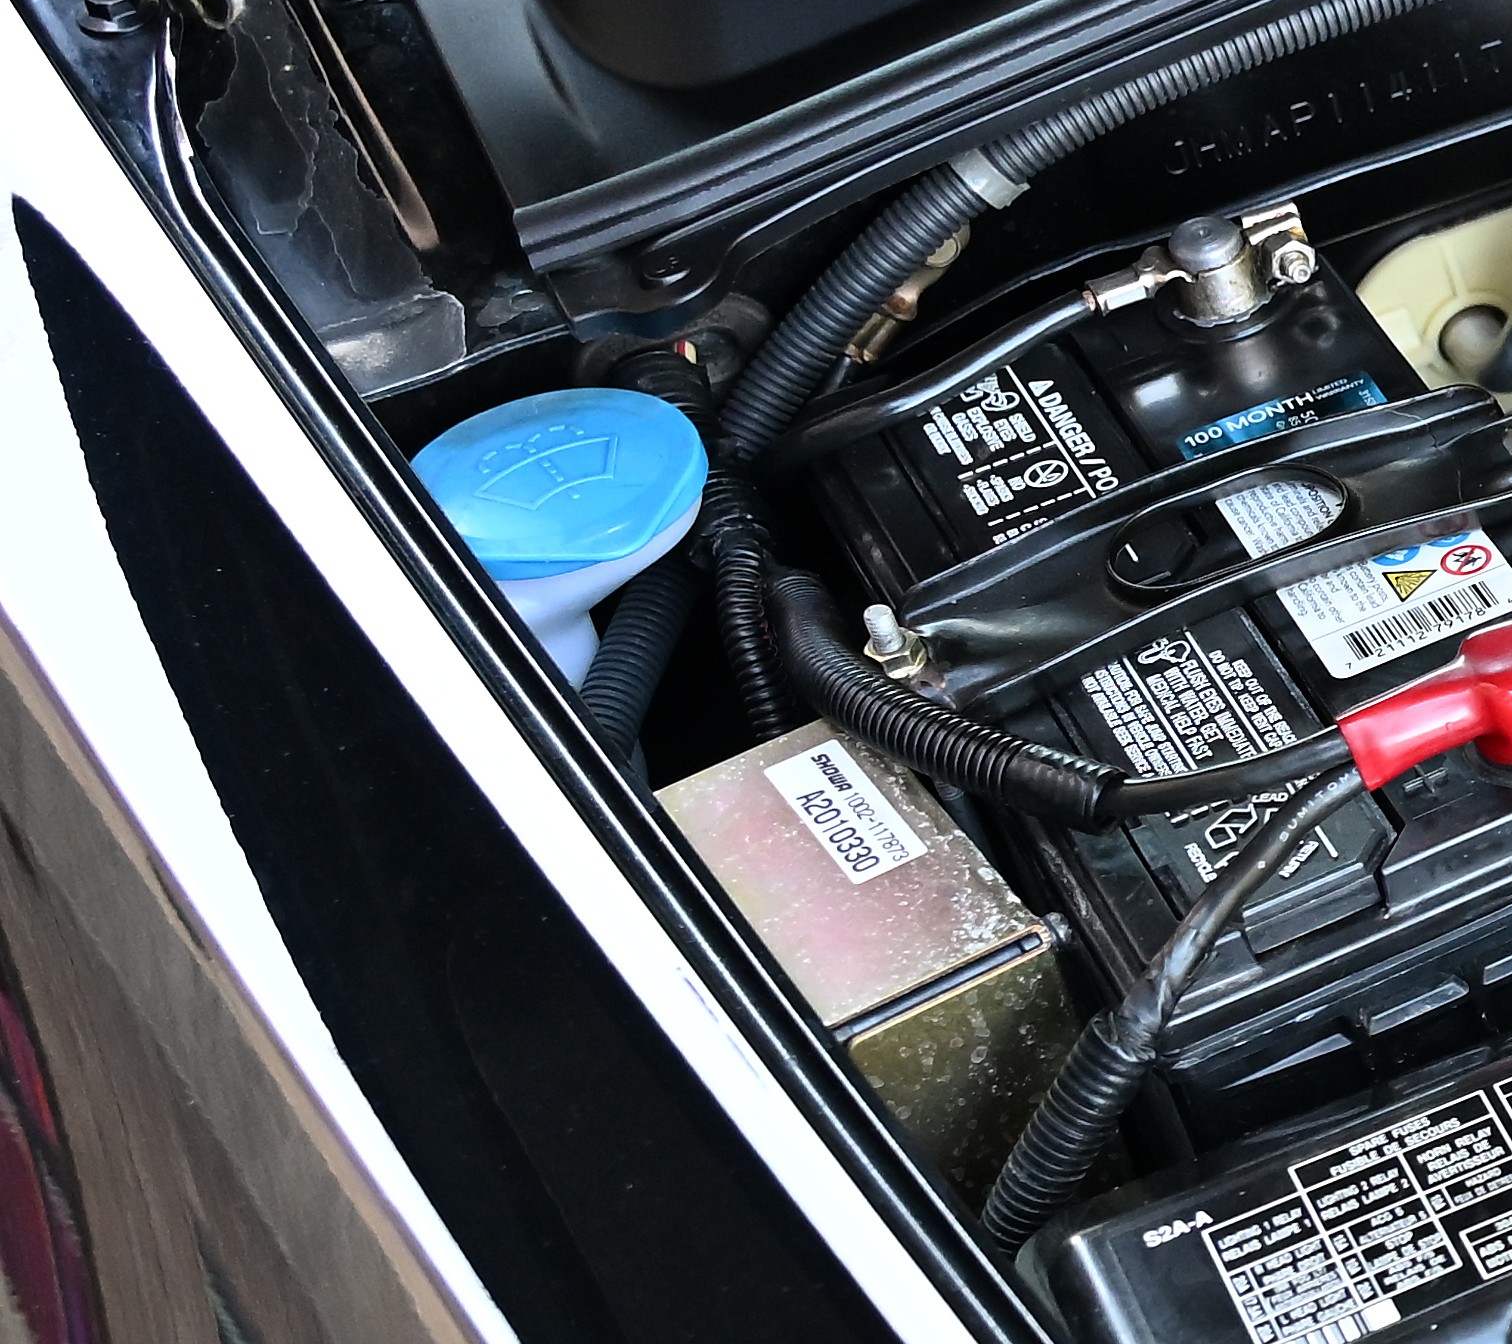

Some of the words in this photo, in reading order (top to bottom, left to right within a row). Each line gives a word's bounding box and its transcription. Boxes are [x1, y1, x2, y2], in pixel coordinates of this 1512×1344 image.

[1037, 391, 1097, 457] DANGER
[1182, 425, 1224, 449] 100
[1224, 390, 1315, 433] MONTH
[1374, 631, 1427, 657] 21112
[1431, 606, 1487, 633] 79178
[1162, 666, 1190, 692] WITH
[1198, 722, 1225, 744] GET
[1179, 659, 1210, 690] FLUSH
[1198, 688, 1226, 713] EYES
[1144, 672, 1182, 713] MEDICAL
[1168, 711, 1198, 738] HELP
[1185, 735, 1214, 761] FAST
[811, 754, 853, 792] SHOWA
[844, 792, 910, 862] 1002-117873
[1251, 792, 1289, 803] LEAD
[796, 790, 880, 873] A2010330
[1329, 1149, 1380, 1178] FUSIBLE
[1403, 1116, 1461, 1148] SECOURS
[1347, 1133, 1388, 1158] SPARE
[1391, 1115, 1432, 1140] FUSES
[1416, 1142, 1453, 1165] HORN
[1454, 1125, 1493, 1149] RELAY
[1426, 1148, 1470, 1173] RELAIS
[1140, 1206, 1214, 1250] S2A-A
